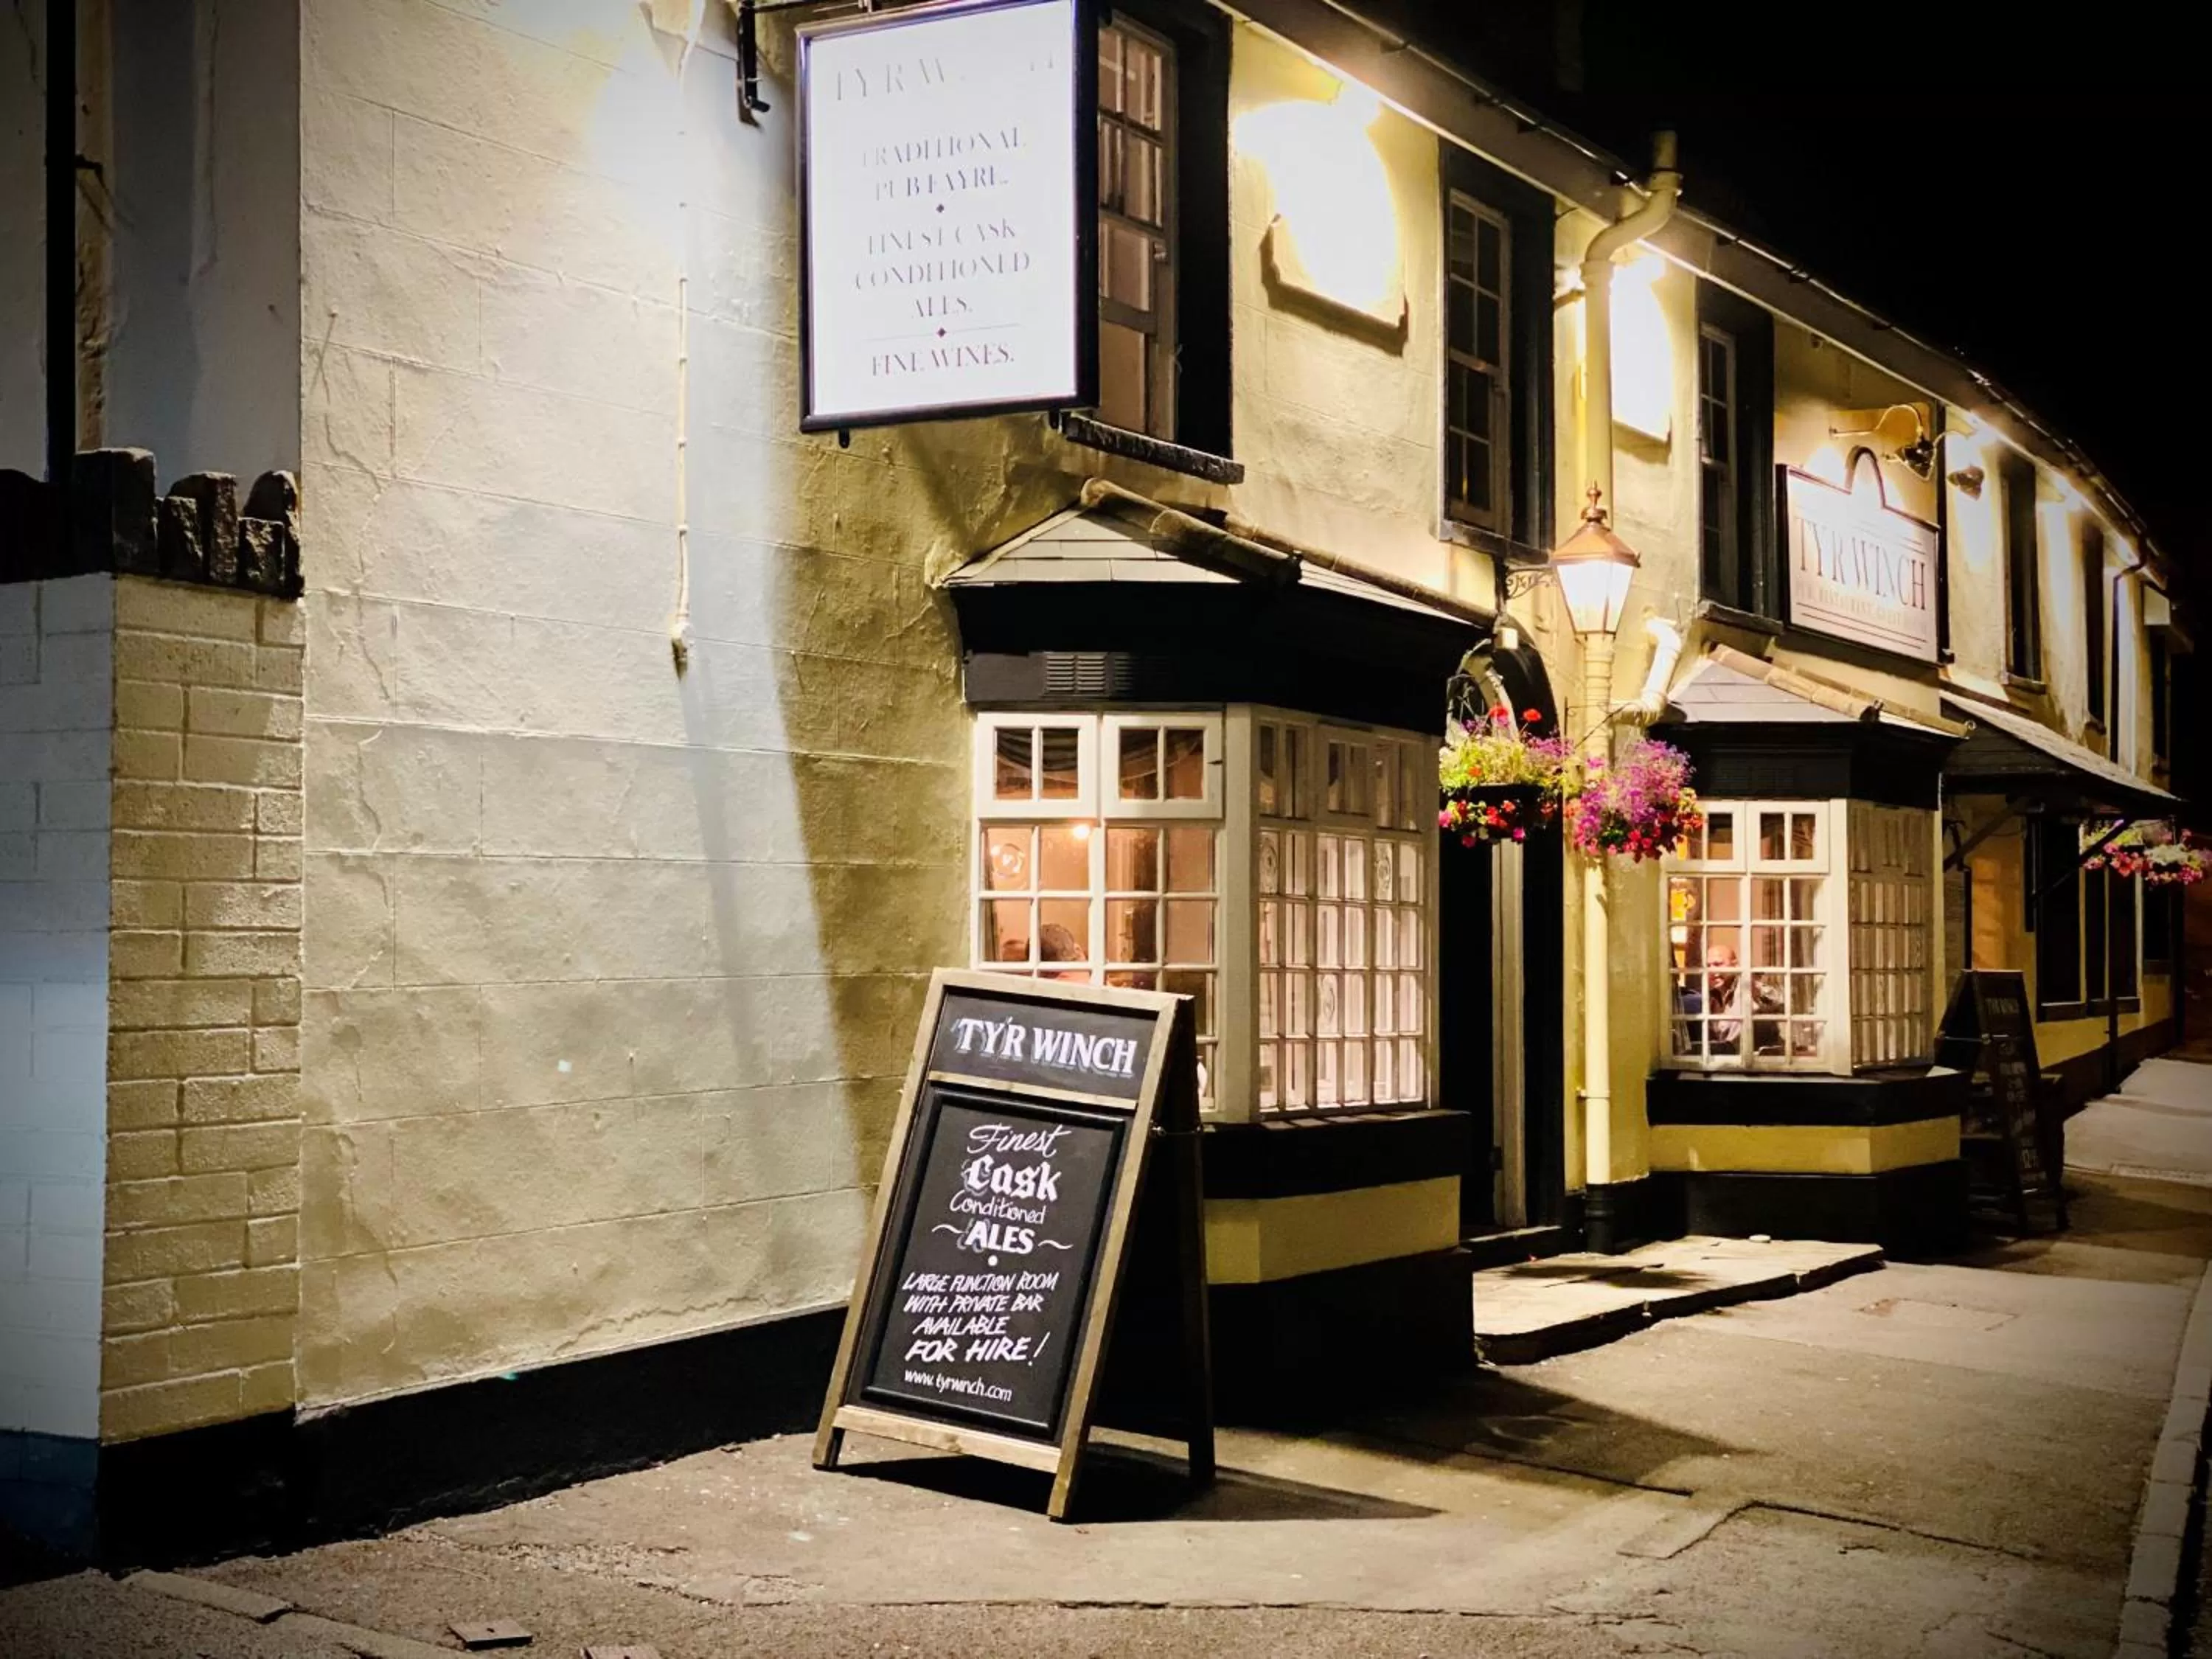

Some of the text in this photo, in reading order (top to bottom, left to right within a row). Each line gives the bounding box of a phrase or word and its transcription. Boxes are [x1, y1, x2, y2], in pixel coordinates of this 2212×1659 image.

[862, 127, 1026, 168] TRADITIONAL
[875, 175, 921, 201] PUB
[868, 218, 1016, 255] FINEST CASK
[852, 251, 1031, 291] CONDITIONED
[872, 348, 925, 378] FINE
[1032, 1026, 1138, 1077] WINCH
[967, 1123, 1073, 1158] Finest
[962, 1154, 1062, 1201] Cask
[949, 1189, 1047, 1225] Conditioned
[902, 1270, 1060, 1293] LARGE FUNCTION ROOM
[903, 1293, 1045, 1313] WITH PRIVATE BAR
[912, 1314, 1011, 1336] AVAILABLE
[904, 1337, 959, 1363] FOR
